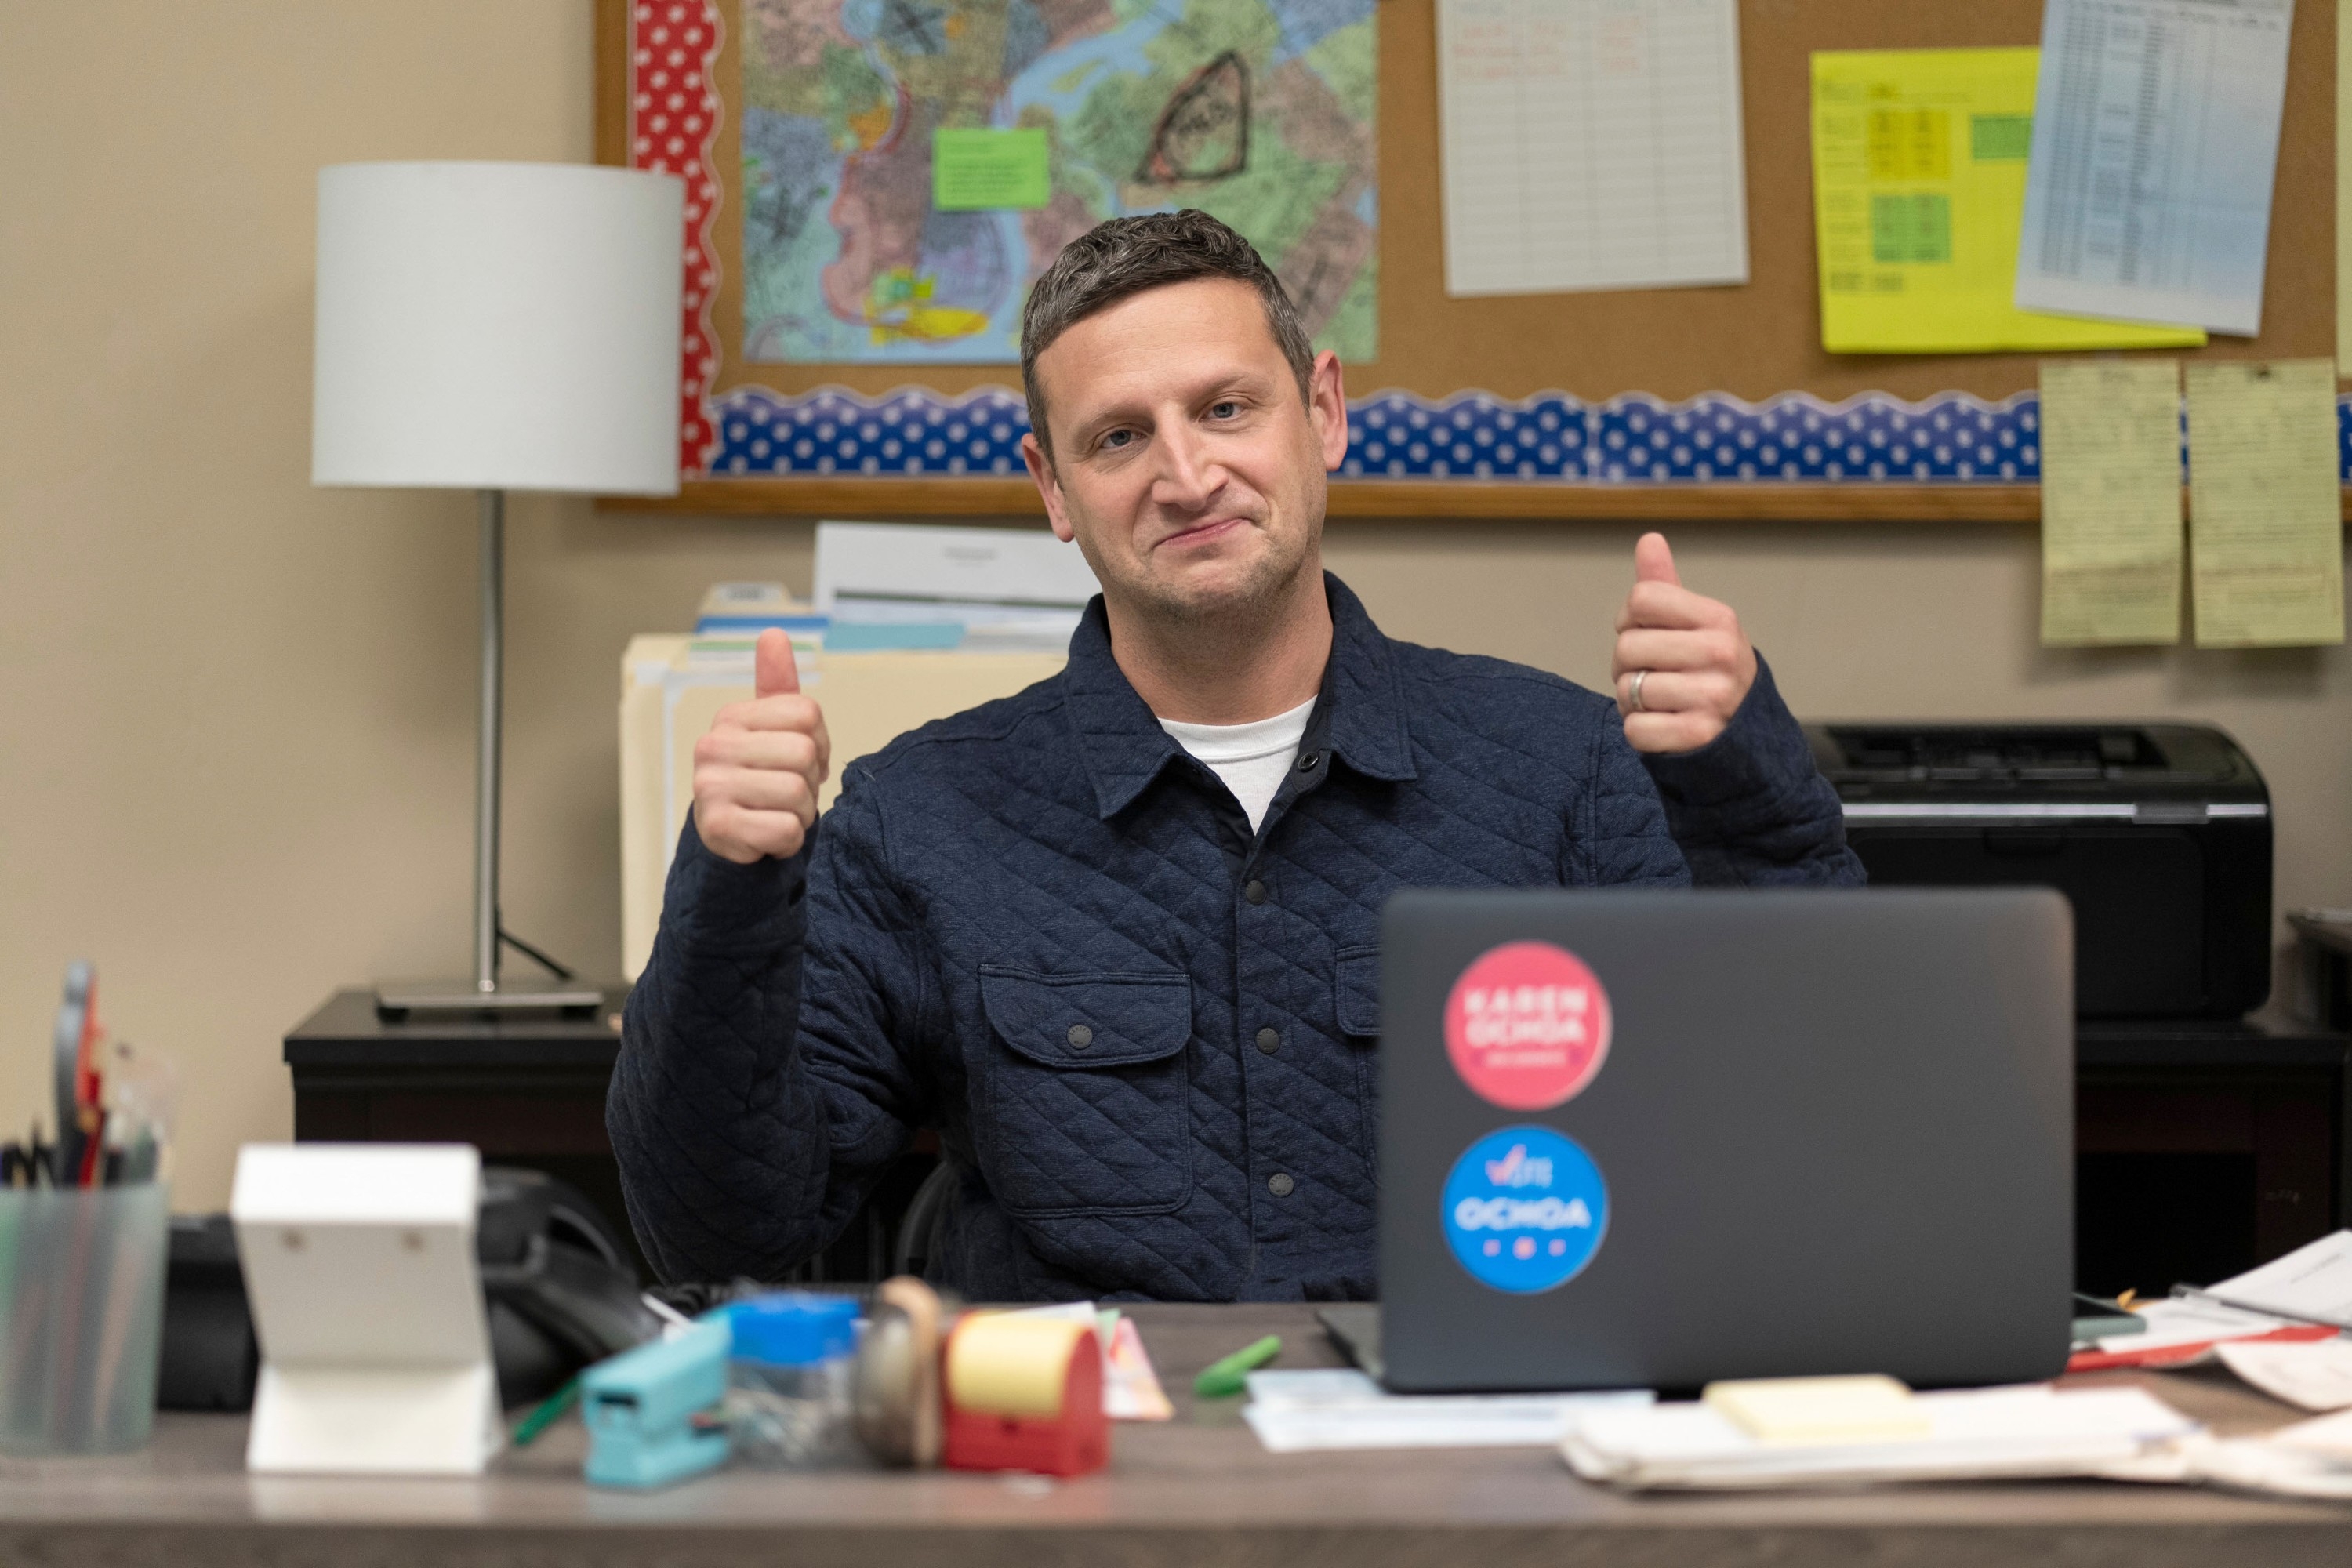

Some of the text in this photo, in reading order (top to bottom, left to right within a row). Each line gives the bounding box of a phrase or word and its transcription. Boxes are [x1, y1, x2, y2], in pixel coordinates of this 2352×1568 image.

[1465, 986, 1588, 1014] KAREN
[1465, 1017, 1586, 1047] OCHOA
[1454, 1197, 1592, 1231] OCHOA
